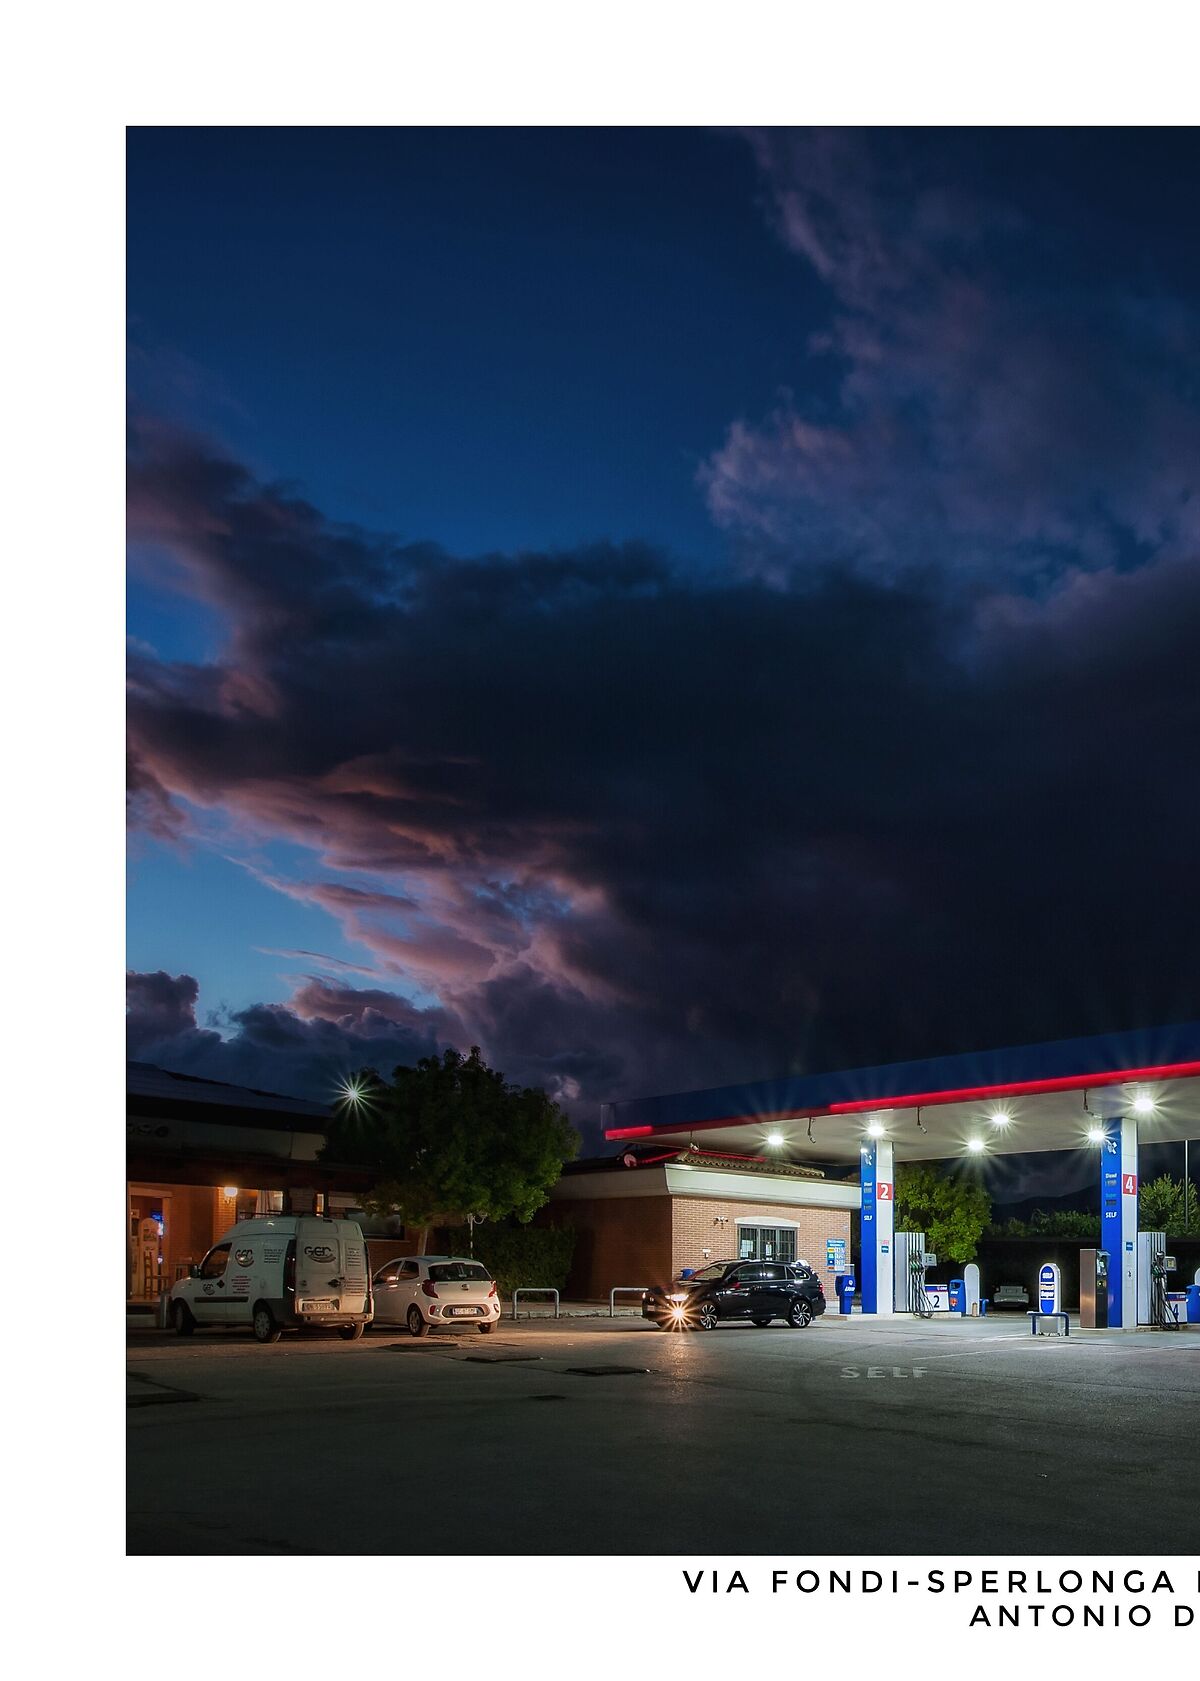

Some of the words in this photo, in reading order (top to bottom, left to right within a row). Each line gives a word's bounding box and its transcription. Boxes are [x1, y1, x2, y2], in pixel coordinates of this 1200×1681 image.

[880, 1183, 889, 1199] 2
[1125, 1175, 1134, 1194] 4
[933, 1294, 940, 1308] 2
[840, 1366, 928, 1378] SELF
